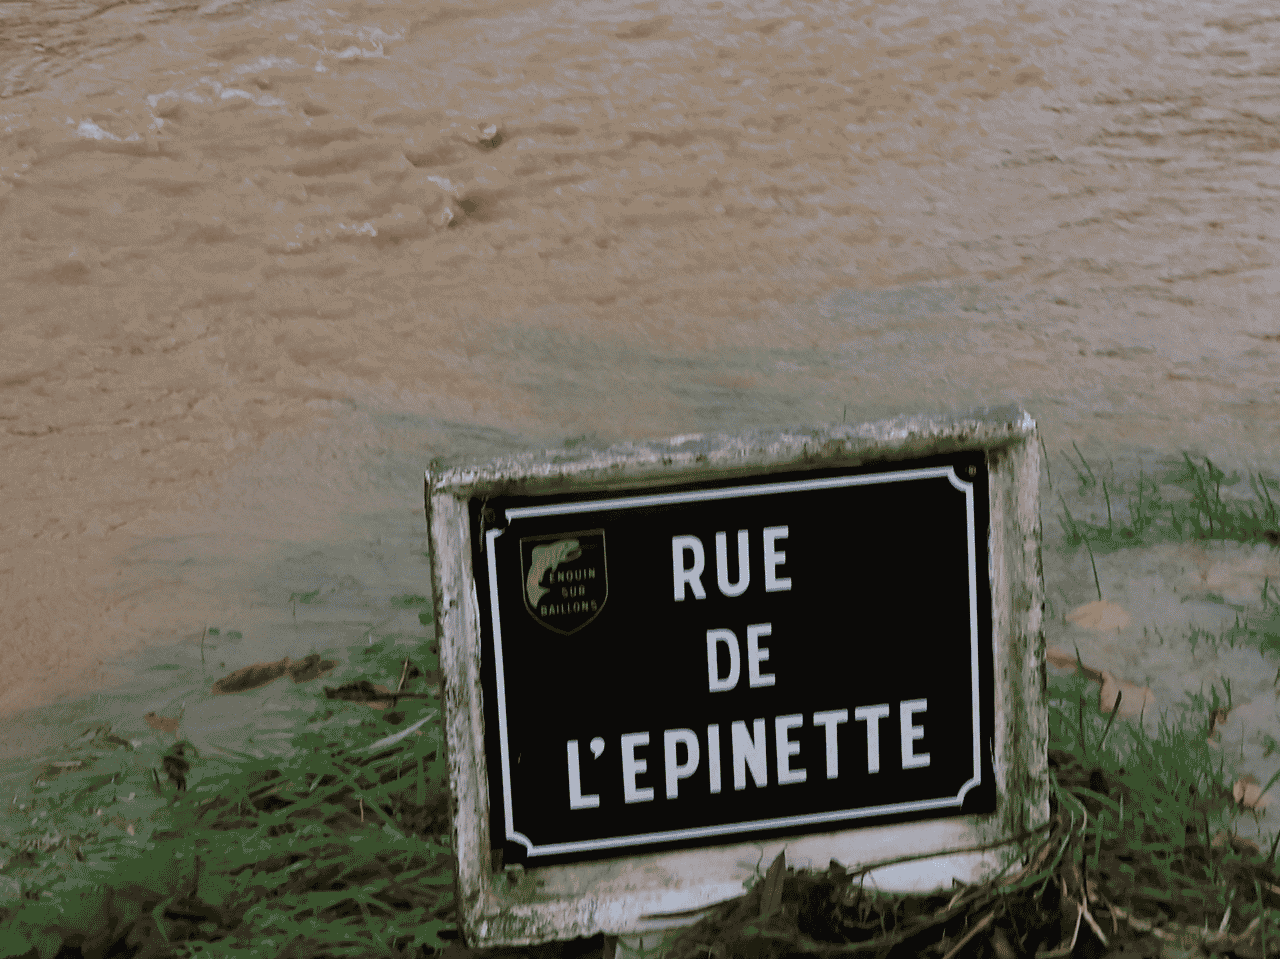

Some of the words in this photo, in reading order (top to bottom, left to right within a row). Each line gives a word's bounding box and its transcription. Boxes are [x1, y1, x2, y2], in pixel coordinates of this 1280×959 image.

[561, 584, 586, 599] SUR
[671, 525, 792, 602] RUE
[540, 599, 598, 617] BAILLONS
[706, 622, 776, 693] DE
[566, 698, 931, 810] L'EPINETTE
